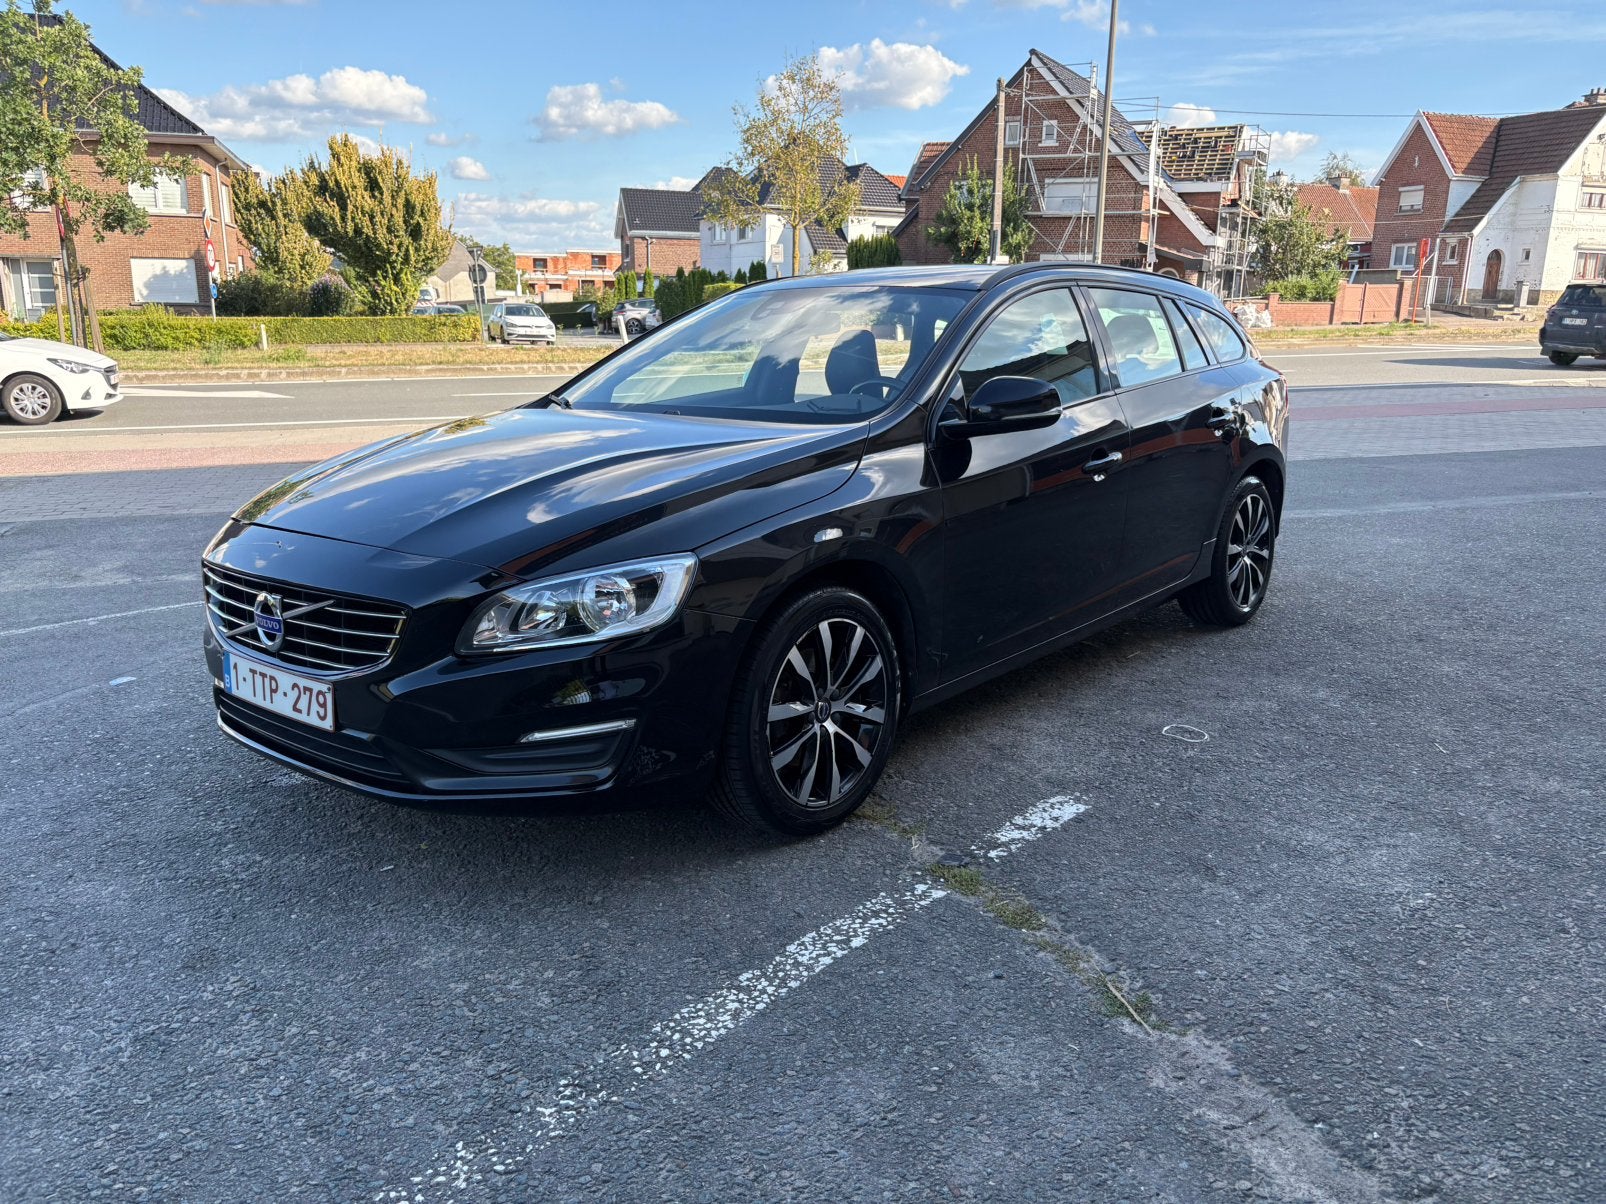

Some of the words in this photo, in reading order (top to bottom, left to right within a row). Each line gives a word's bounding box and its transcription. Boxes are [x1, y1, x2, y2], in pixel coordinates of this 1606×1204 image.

[256, 616, 279, 630] VOLVO
[225, 674, 231, 688] B
[233, 662, 328, 721] 1-TTP-279
